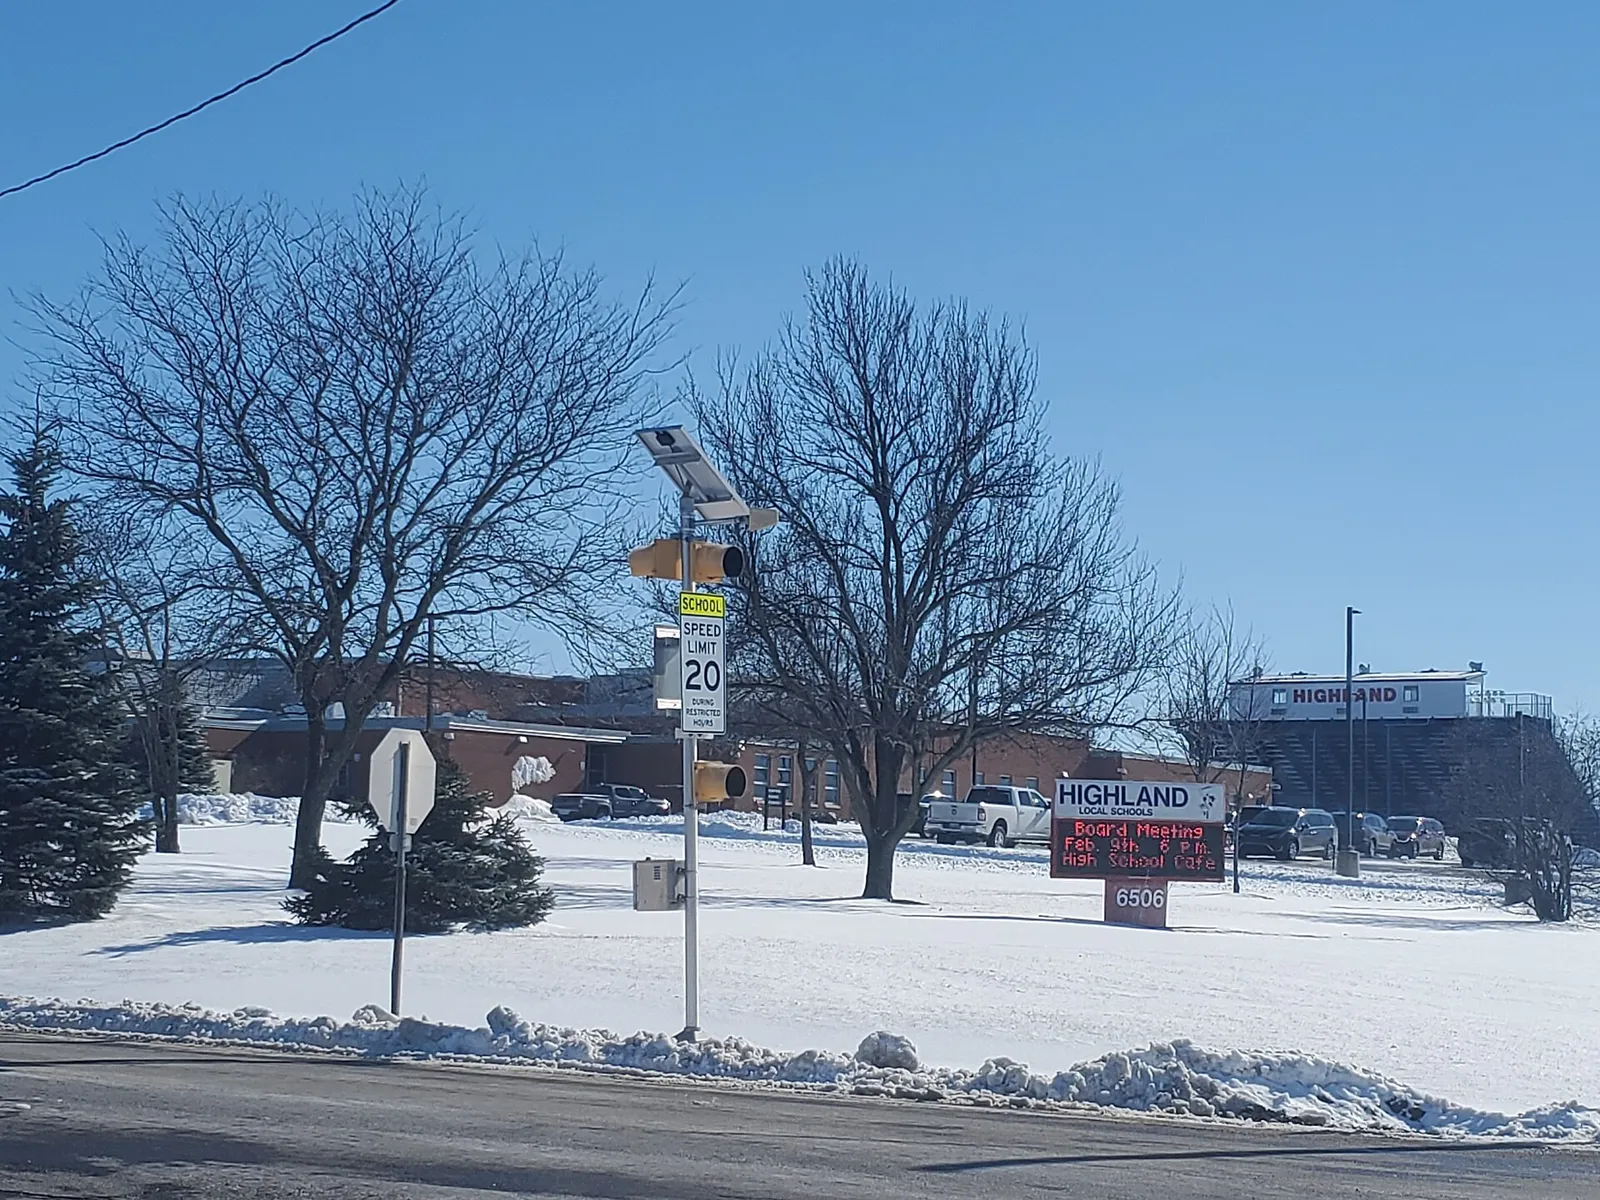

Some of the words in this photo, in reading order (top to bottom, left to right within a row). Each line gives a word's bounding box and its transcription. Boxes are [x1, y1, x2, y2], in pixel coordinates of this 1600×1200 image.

[682, 597, 722, 613] SCHOOL
[684, 622, 721, 637] SPEED
[688, 640, 717, 655] LIMIT
[685, 659, 720, 691] 20
[692, 698, 715, 706] DURING
[686, 708, 721, 717] RESTRICTED
[693, 719, 713, 727] HOURS
[1059, 784, 1189, 808] HIGHLAND
[1079, 807, 1108, 816] LOCAL
[1111, 808, 1153, 817] SCHOOLS
[1074, 821, 1128, 838] Board
[1137, 823, 1204, 839] Meeting
[1064, 837, 1100, 853] Feb.
[1062, 853, 1098, 868] High
[1108, 854, 1165, 869] School
[1174, 855, 1217, 871] Cafe
[1116, 888, 1165, 908] 6506
